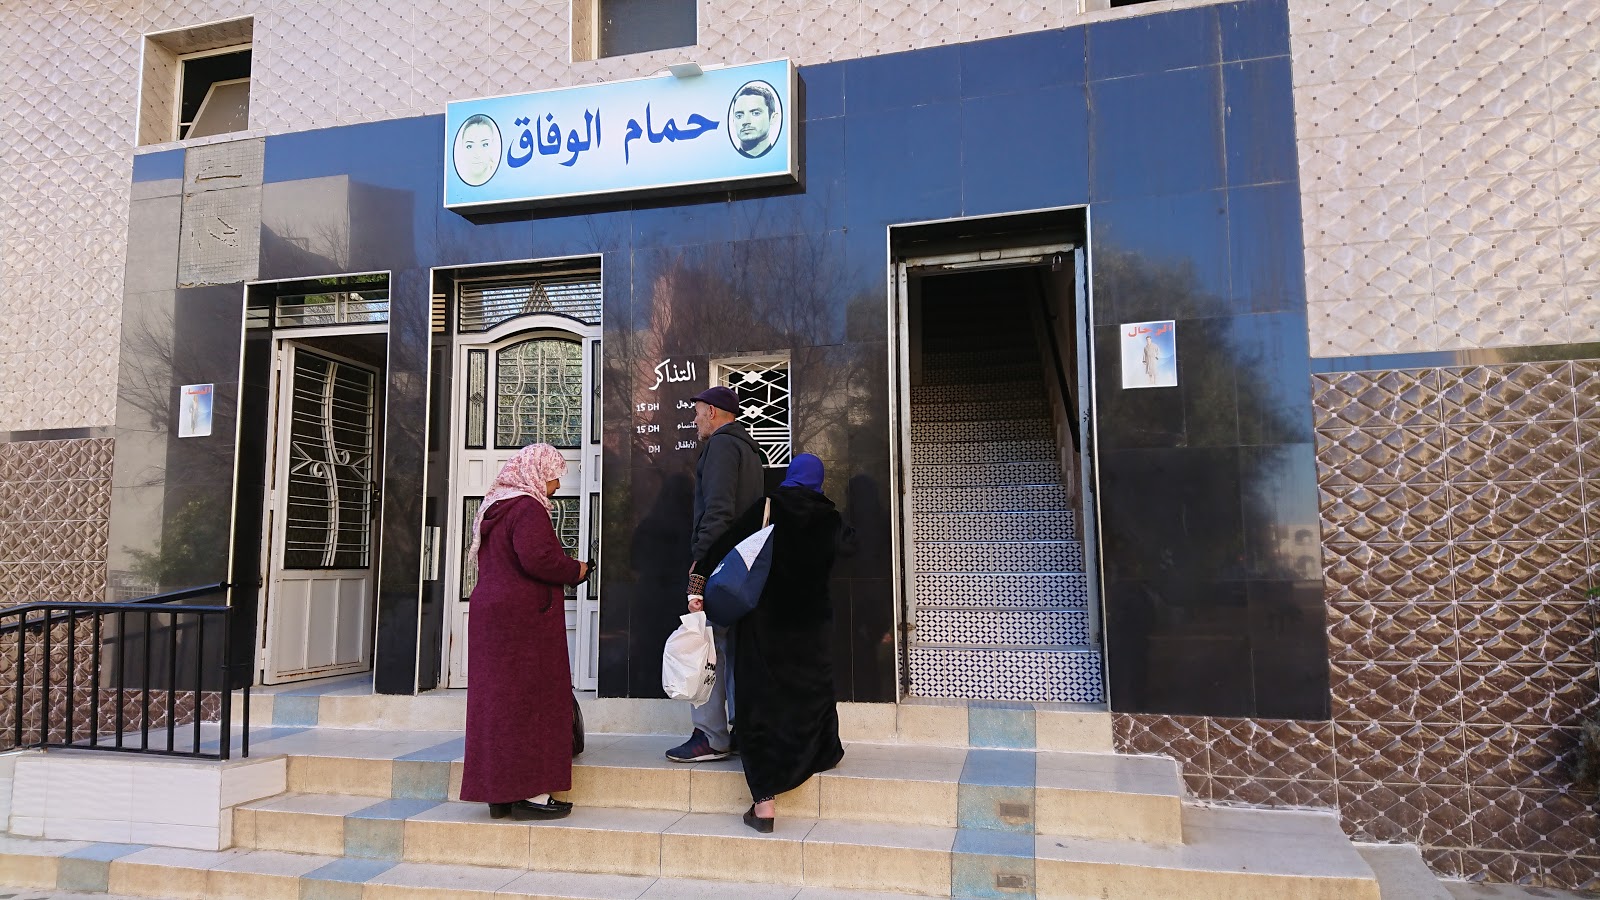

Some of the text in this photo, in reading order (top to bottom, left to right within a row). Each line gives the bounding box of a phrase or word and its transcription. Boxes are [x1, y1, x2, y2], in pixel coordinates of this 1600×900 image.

[506, 101, 720, 169] حمام الوفاق
[1128, 323, 1172, 336] الرجال
[648, 358, 697, 391] التذاكر
[636, 402, 660, 411] 15 DH
[636, 424, 660, 434] 15 DH
[676, 421, 697, 430] لنساء
[648, 445, 661, 453] DH
